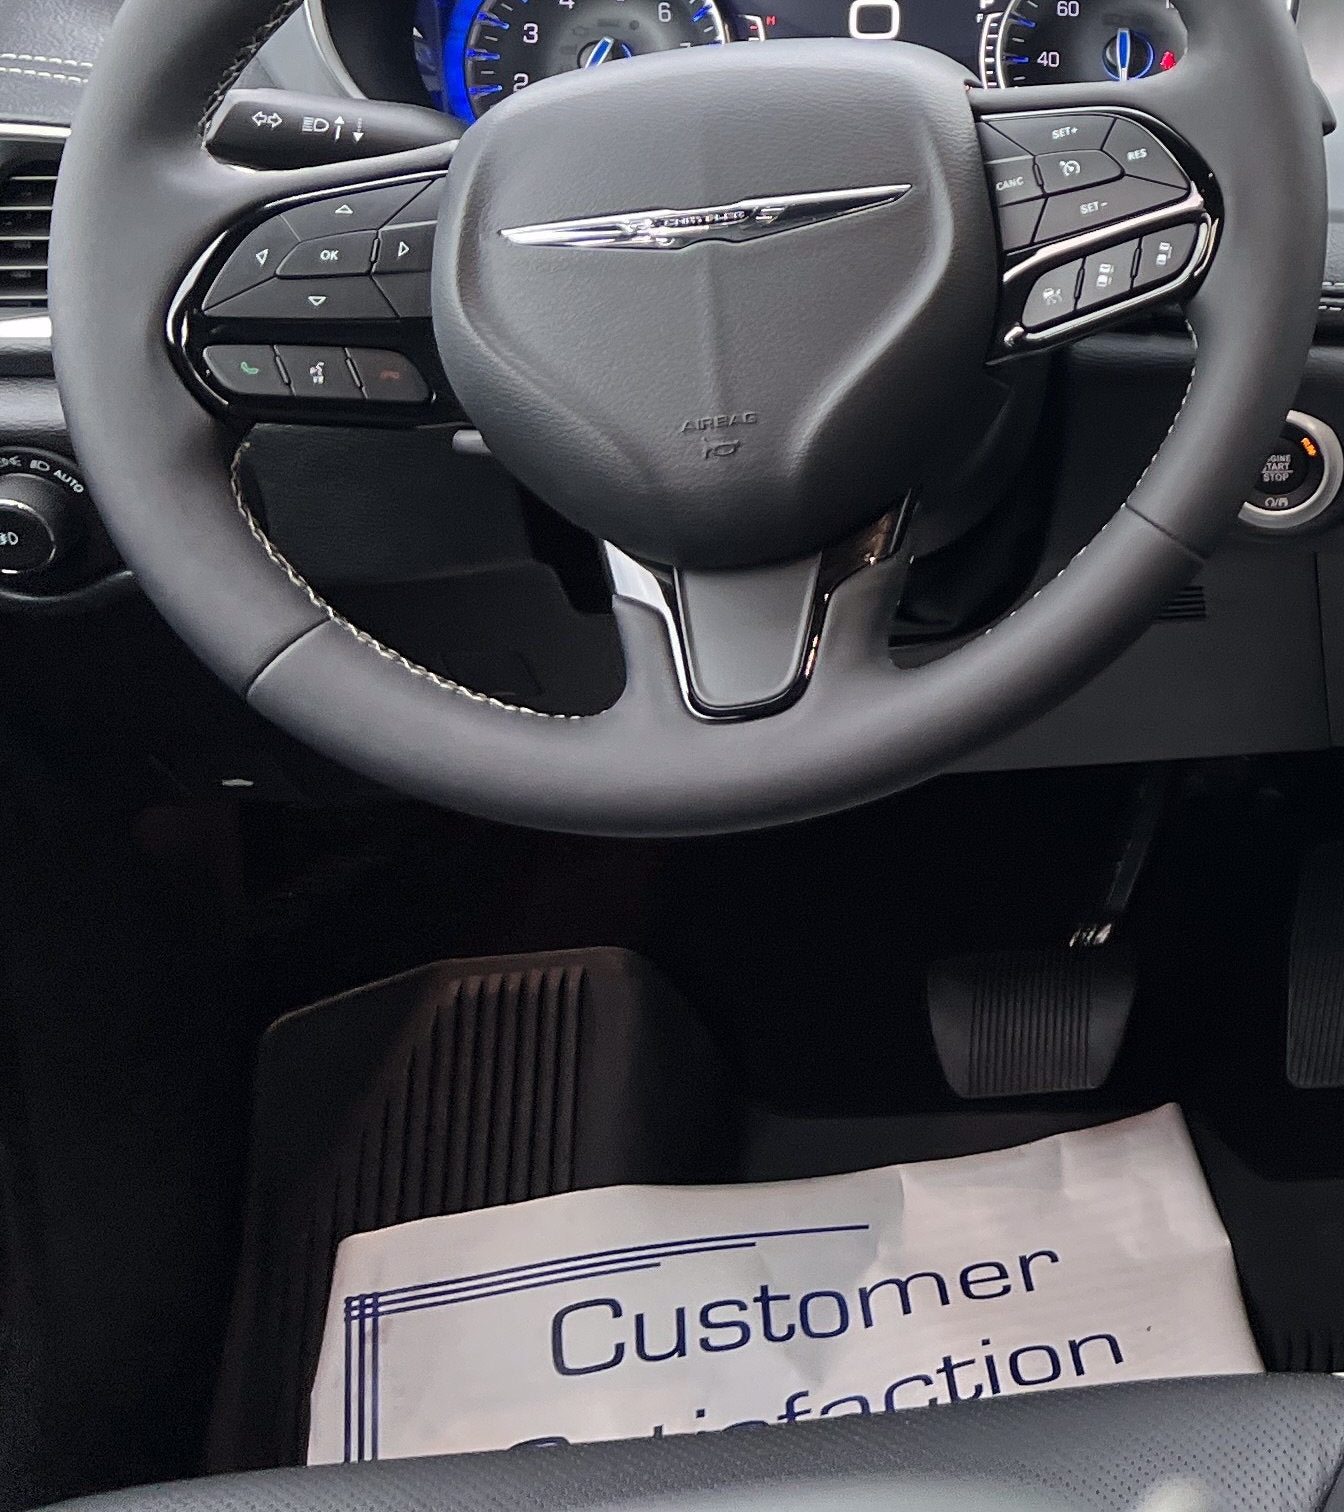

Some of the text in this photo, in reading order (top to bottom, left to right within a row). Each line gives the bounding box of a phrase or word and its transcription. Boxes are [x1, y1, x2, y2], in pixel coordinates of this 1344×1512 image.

[658, 2, 672, 23] 6
[1057, 0, 1079, 17] 60
[523, 23, 539, 44] 3
[1037, 51, 1060, 68] 40
[514, 73, 529, 92] 2
[1052, 126, 1078, 140] SET+
[1127, 148, 1147, 161] RES
[996, 176, 1024, 191] CANC
[320, 250, 339, 261] OK
[681, 411, 757, 433] AIRBAG
[1264, 462, 1289, 471] TART
[54, 469, 84, 493] AUTO
[1262, 473, 1289, 482] STOP
[551, 1249, 1061, 1377] Customer
